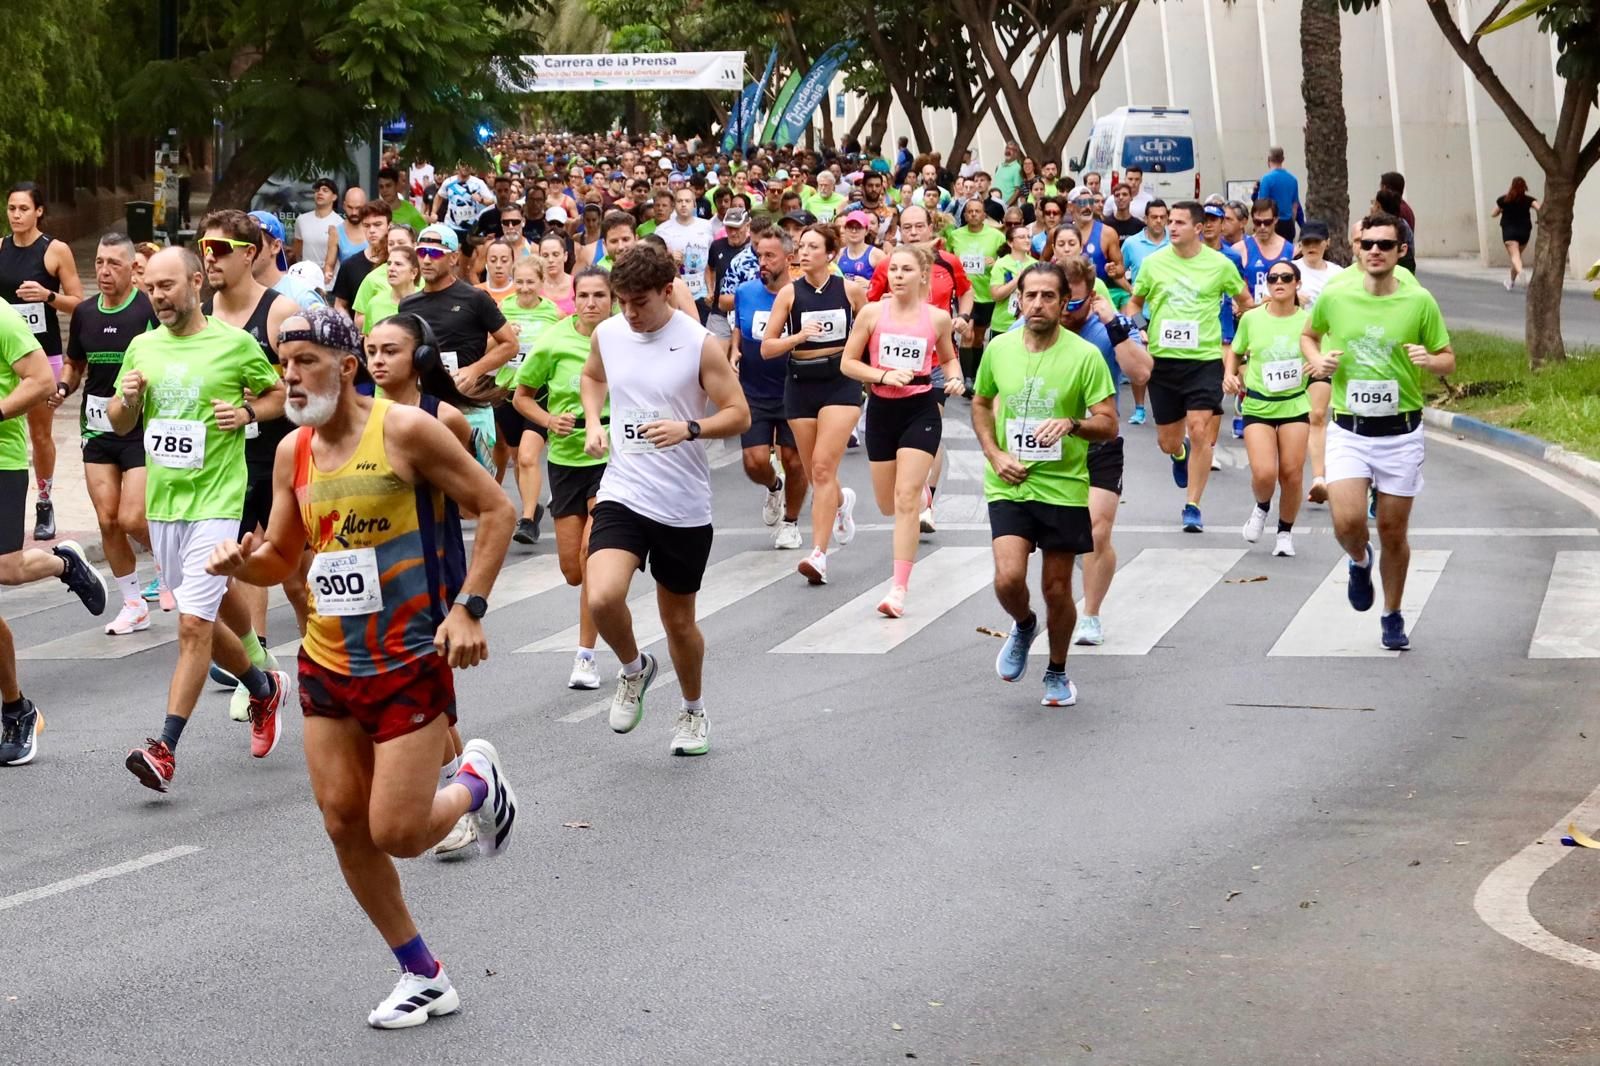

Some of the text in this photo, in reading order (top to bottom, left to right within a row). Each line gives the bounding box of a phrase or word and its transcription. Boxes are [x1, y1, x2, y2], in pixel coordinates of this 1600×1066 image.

[544, 56, 677, 68] Carrera de la Prensa
[789, 84, 825, 126] Unicaja
[1164, 329, 1191, 340] 621
[883, 345, 921, 359] 1128
[1266, 369, 1298, 381] 1162
[1351, 392, 1393, 403] 1094
[151, 435, 194, 454] 786
[339, 508, 392, 537] Álora
[315, 572, 365, 596] 300
